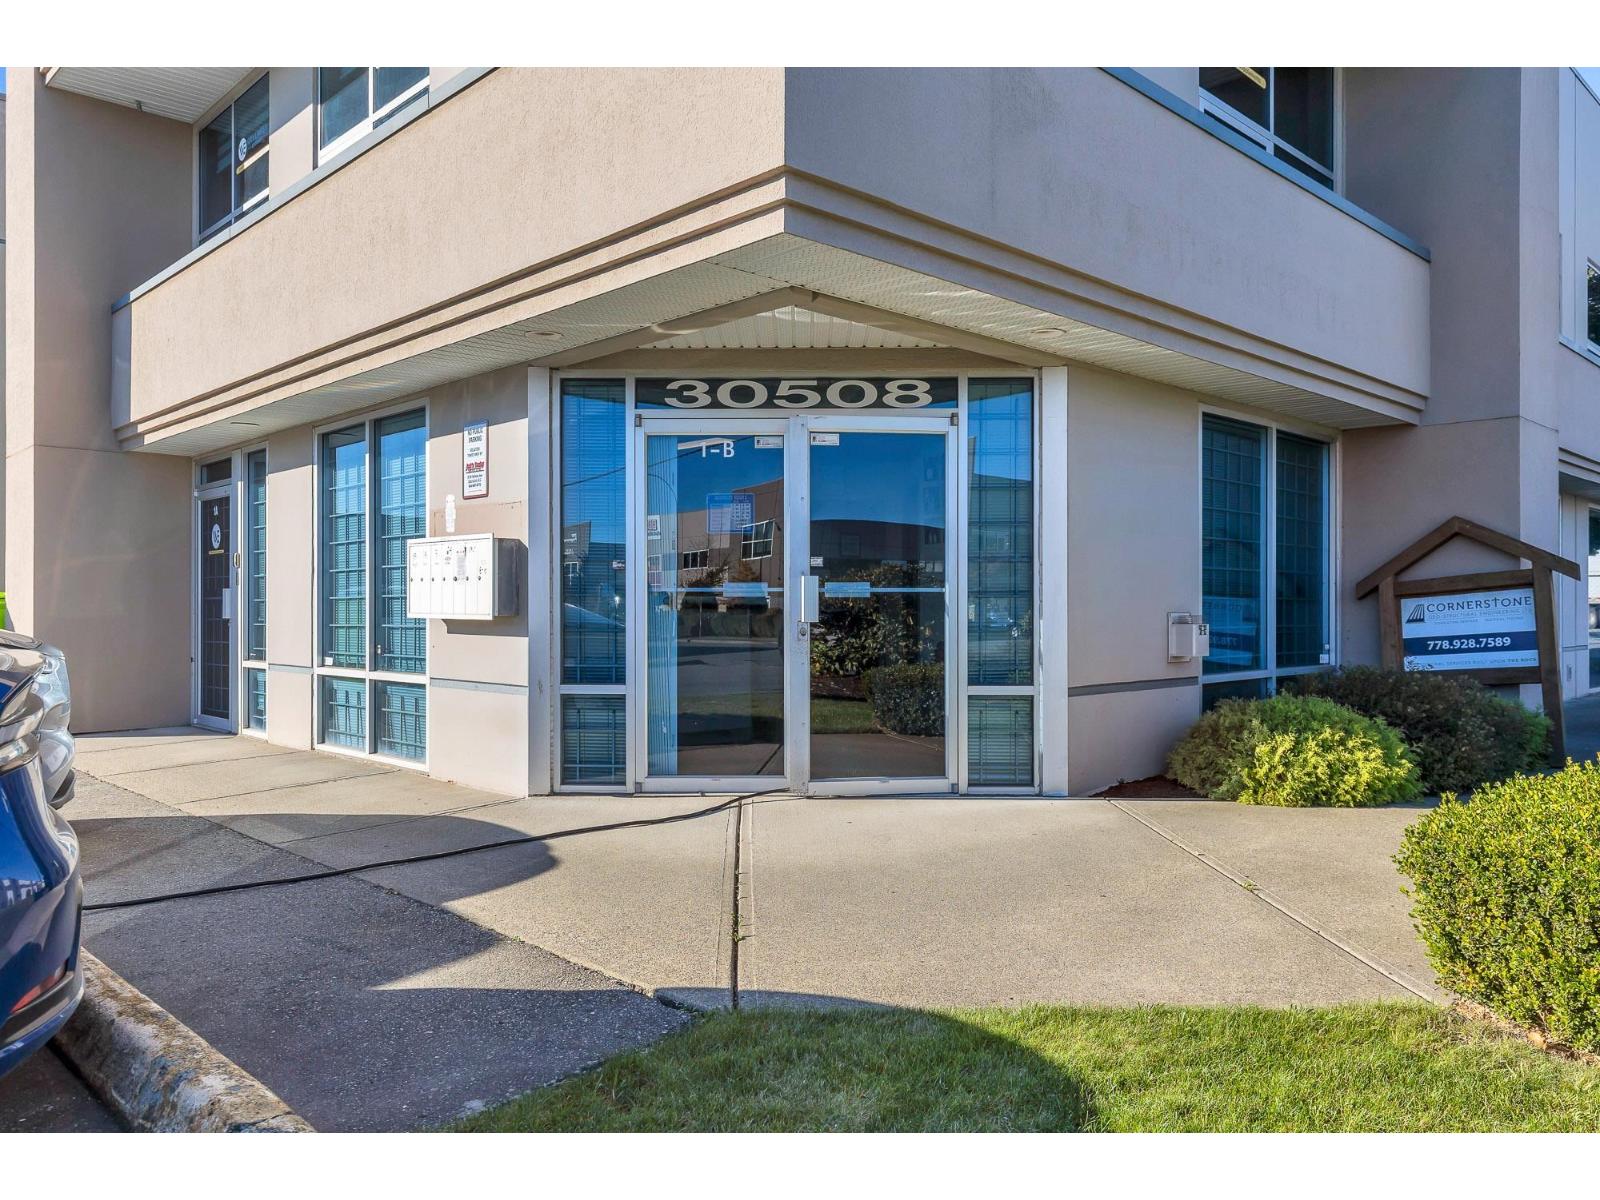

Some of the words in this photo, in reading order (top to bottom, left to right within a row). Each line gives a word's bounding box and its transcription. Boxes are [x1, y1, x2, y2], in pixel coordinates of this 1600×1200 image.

[664, 379, 933, 408] 30508
[1426, 596, 1532, 612] CORNERSTONE
[1427, 637, 1511, 650] 778.928.7589
